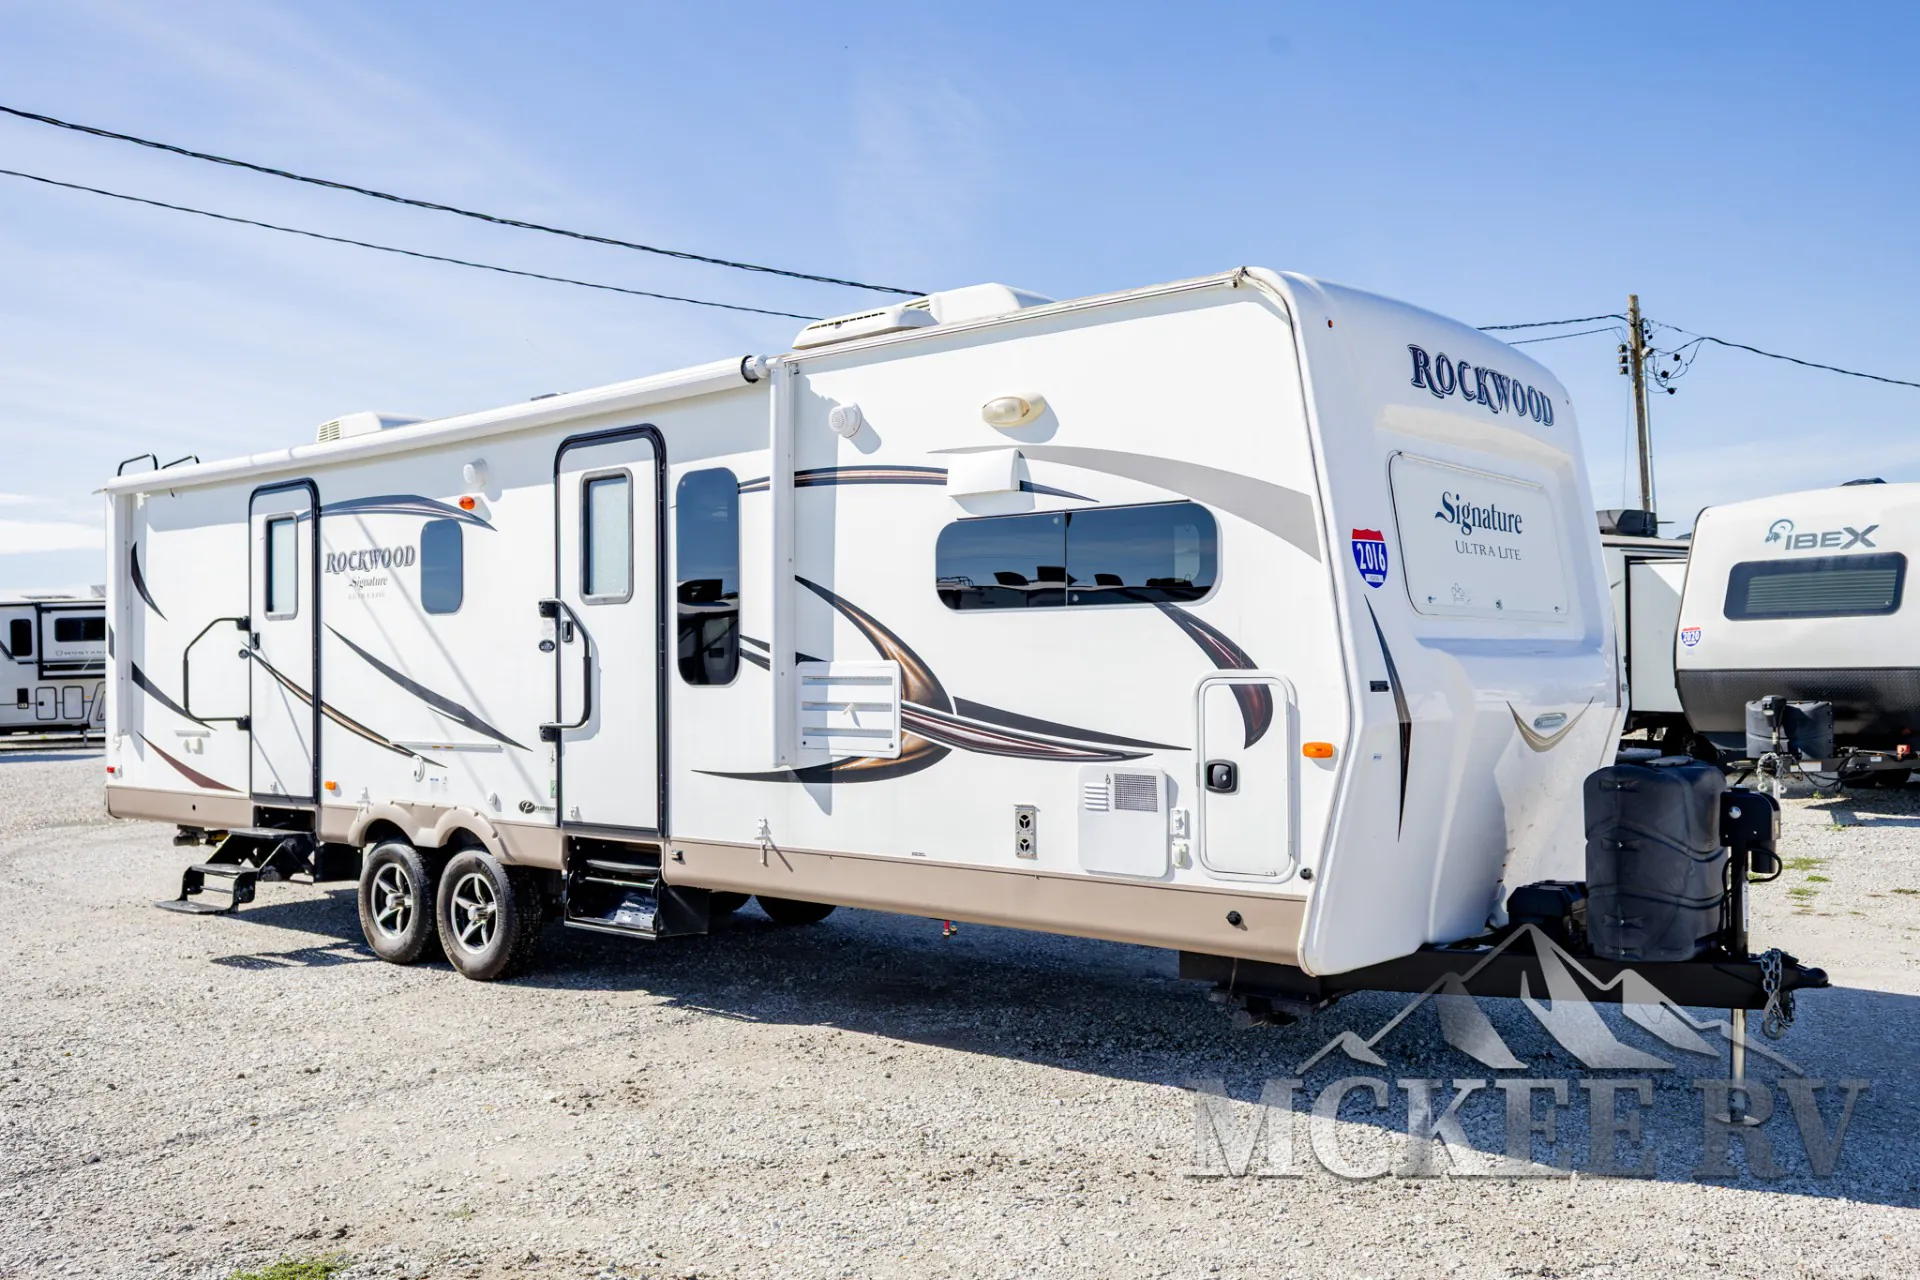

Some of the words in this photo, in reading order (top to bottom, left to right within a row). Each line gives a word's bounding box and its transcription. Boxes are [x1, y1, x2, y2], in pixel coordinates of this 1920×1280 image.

[1407, 344, 1555, 427] ROCKWOOD
[1435, 491, 1523, 536] Signature
[1455, 540, 1497, 557] ULTRA
[1498, 545, 1522, 561] LITE
[1785, 524, 1879, 551] IBEX
[325, 545, 416, 574] ROCKWOOD
[1356, 543, 1386, 572] 2016
[348, 575, 388, 589] Signature
